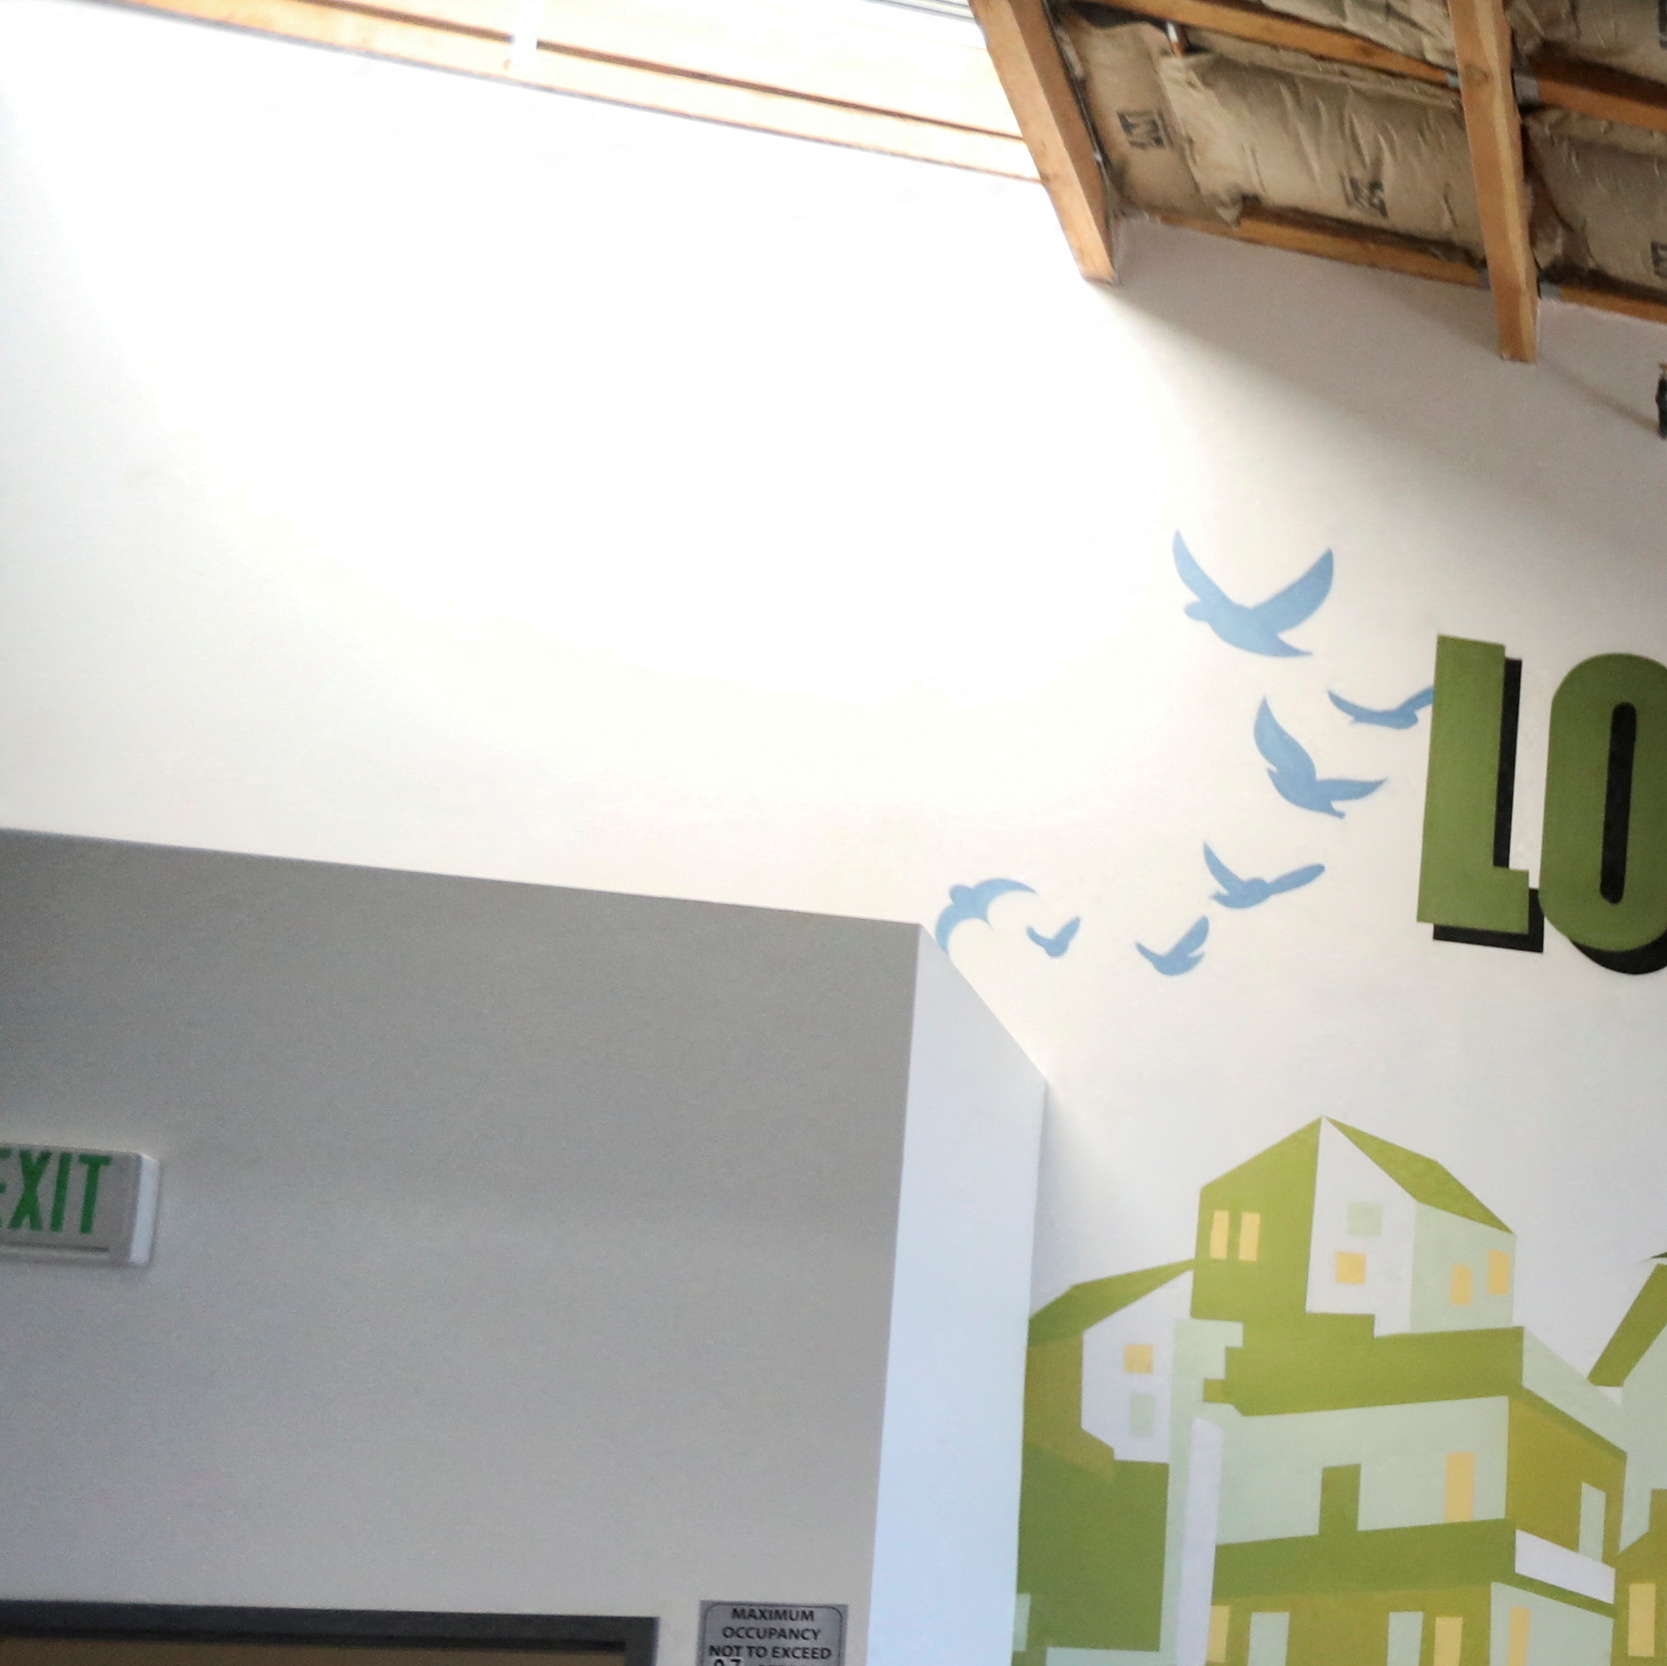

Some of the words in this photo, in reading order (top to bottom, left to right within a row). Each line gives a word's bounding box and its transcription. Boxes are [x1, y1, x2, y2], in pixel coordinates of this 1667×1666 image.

[732, 1607, 815, 1621] MAXIMUM
[722, 1626, 822, 1641] OCCUPANCY
[708, 1645, 741, 1657] NOT
[746, 1647, 767, 1658] TO
[771, 1647, 831, 1659] EXCEED
